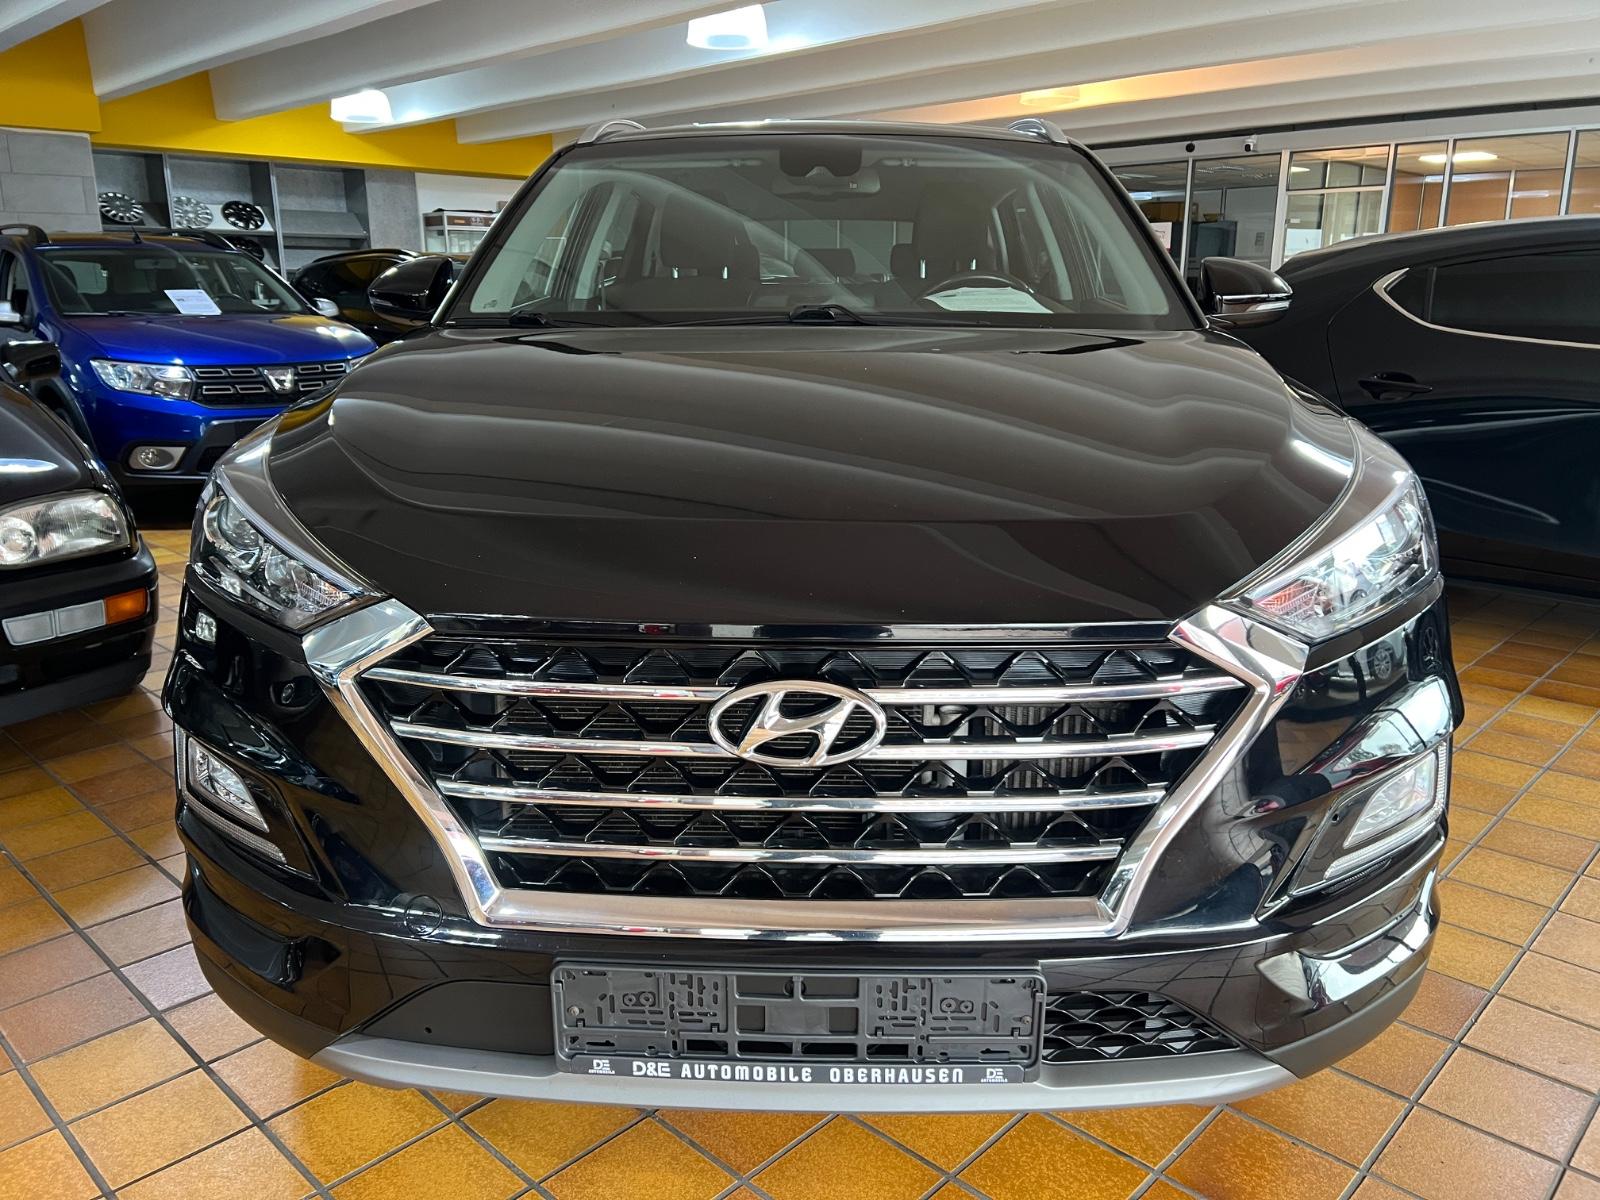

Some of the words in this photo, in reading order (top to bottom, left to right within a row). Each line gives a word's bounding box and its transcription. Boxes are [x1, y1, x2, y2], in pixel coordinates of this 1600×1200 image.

[633, 1061, 671, 1078] D&E
[680, 1063, 812, 1083] AUTOMOBILE
[829, 1067, 963, 1084] OBERHAUSEN
